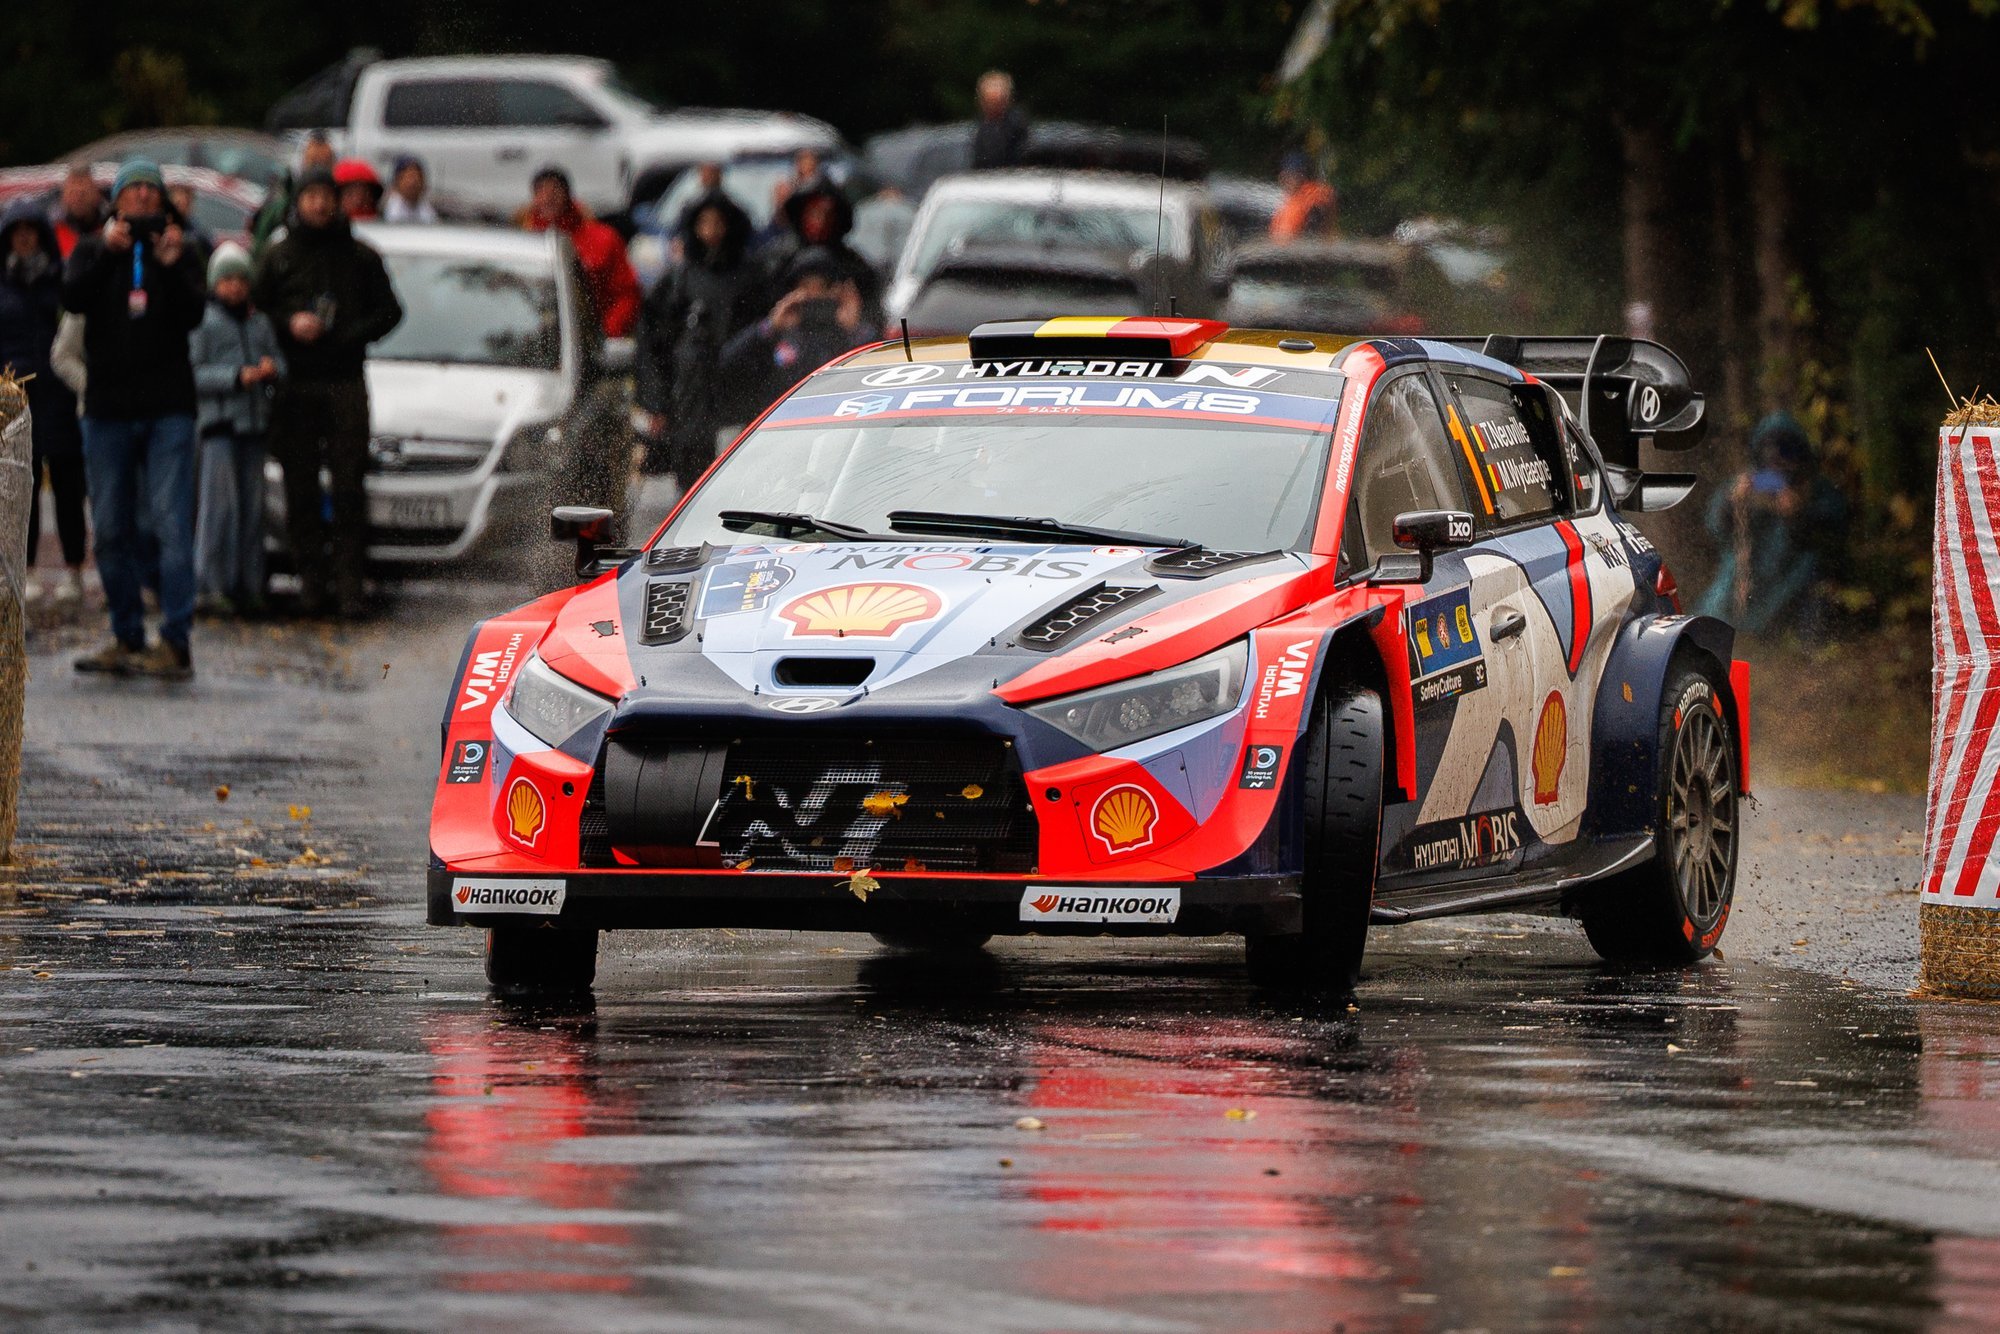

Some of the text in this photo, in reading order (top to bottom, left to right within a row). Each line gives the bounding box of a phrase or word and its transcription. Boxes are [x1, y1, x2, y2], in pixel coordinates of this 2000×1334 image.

[956, 360, 1164, 379] HYUNDAI
[898, 386, 1261, 415] FORUM8
[1335, 382, 1368, 494] motorsport.hyundai.com
[1478, 416, 1531, 450] T.Neuville
[1496, 453, 1552, 494] M.Wydaeghe
[1447, 514, 1471, 537] ixo
[826, 554, 1089, 580] MOBIS
[496, 633, 524, 683] HYUNDAI
[1275, 639, 1315, 698] WIA
[460, 650, 503, 712] WIA
[1255, 665, 1279, 719] HYUNDAI
[1420, 674, 1462, 701] SafetyCulture
[1414, 811, 1521, 869] HYUNDAI MOBIS
